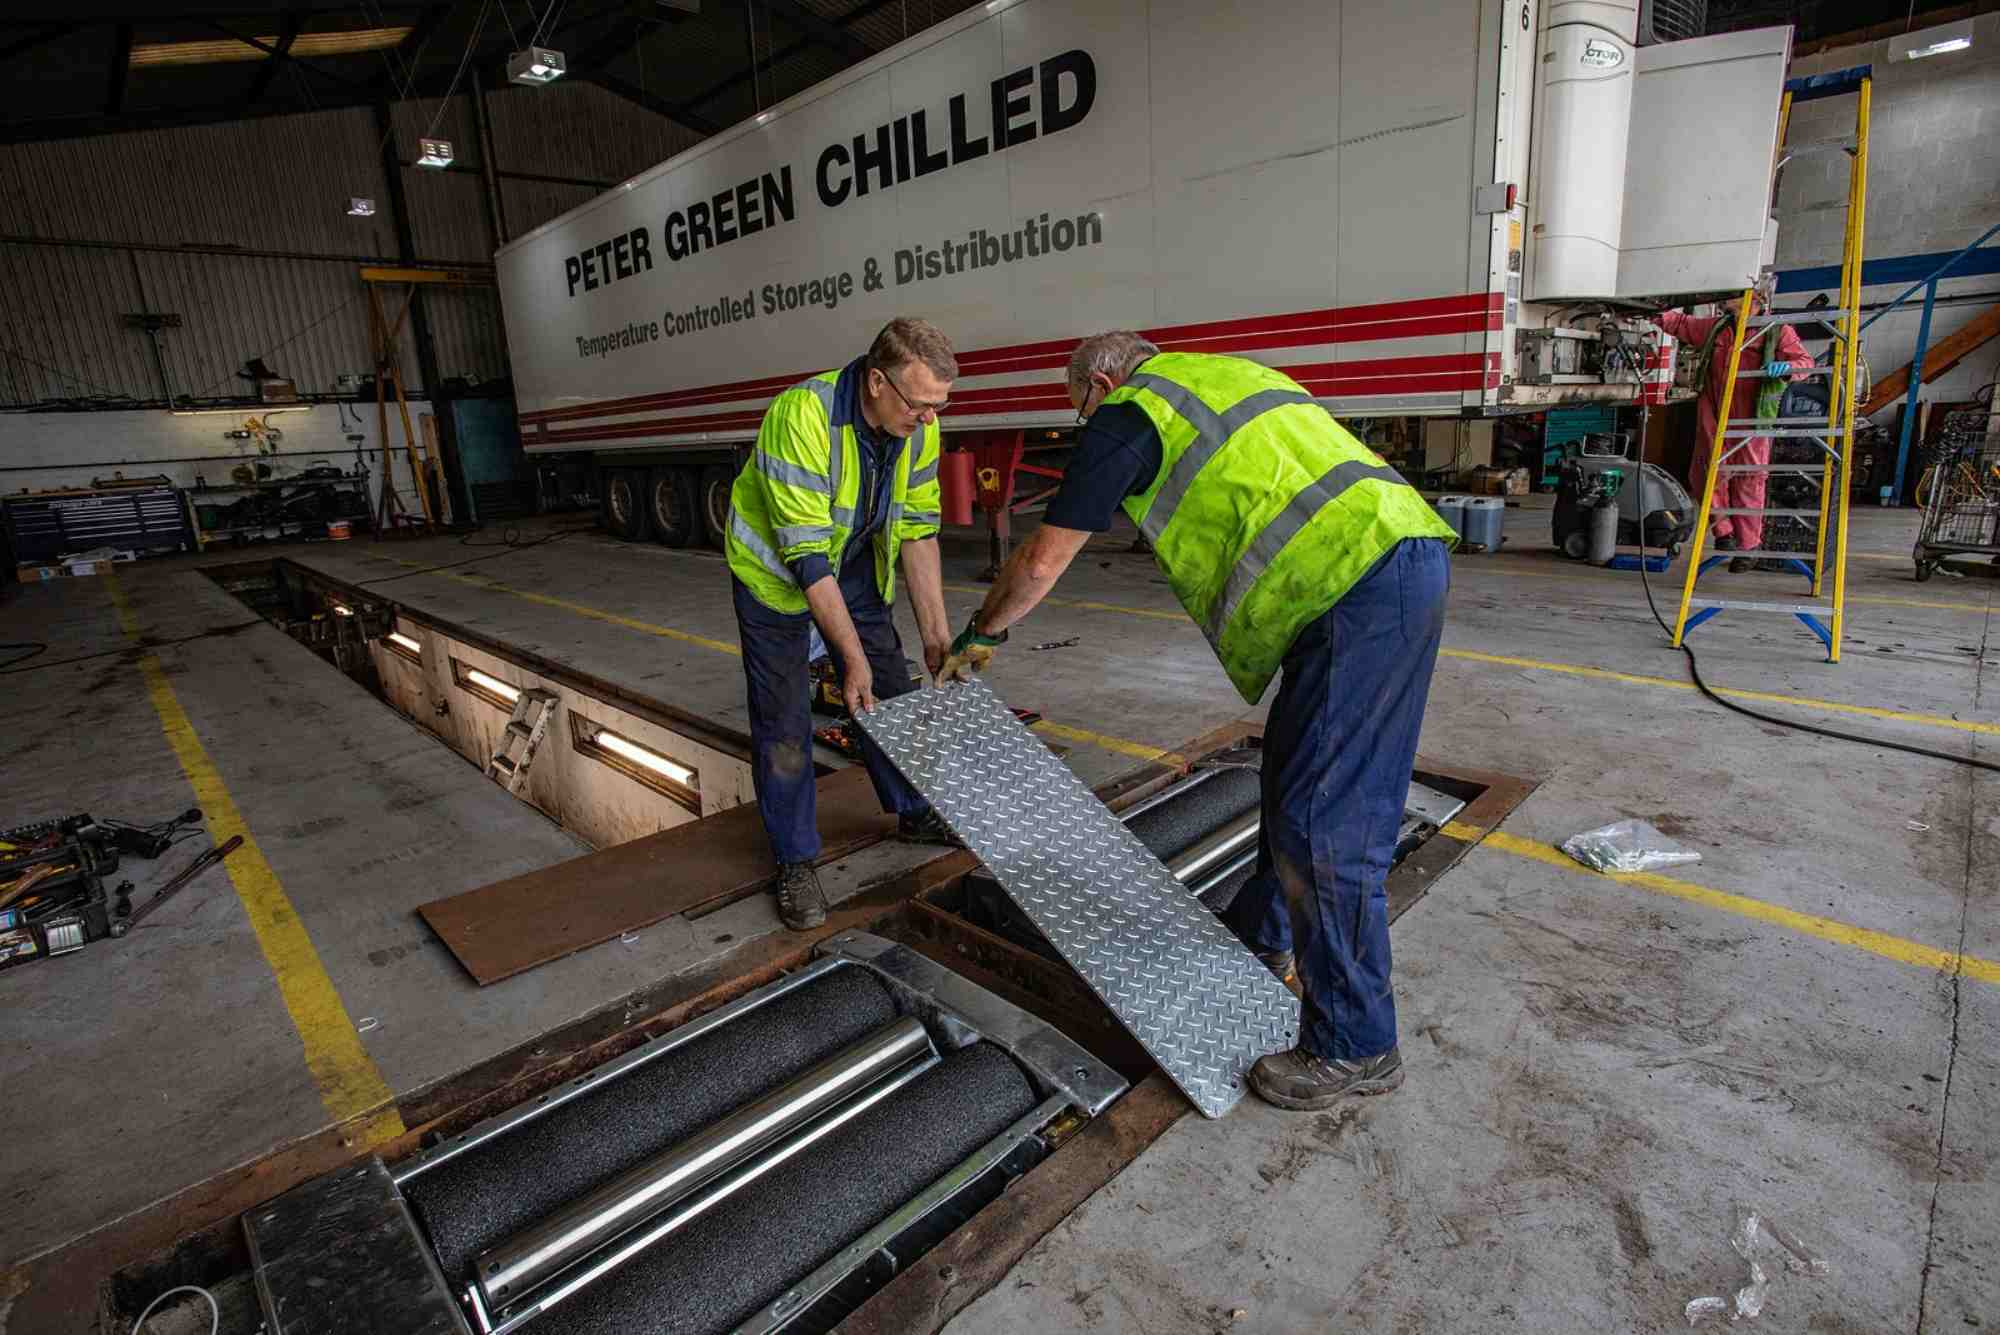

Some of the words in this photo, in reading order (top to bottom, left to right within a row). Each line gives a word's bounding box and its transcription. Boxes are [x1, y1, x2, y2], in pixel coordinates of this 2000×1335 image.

[564, 227, 653, 298] PETER
[664, 164, 797, 262] GREEN
[816, 49, 1096, 208] CHILLED
[576, 322, 659, 358] Temperature
[664, 289, 755, 337] Controlled
[761, 272, 853, 315] Storage
[863, 257, 884, 292] &
[894, 212, 1102, 285] Distribution
